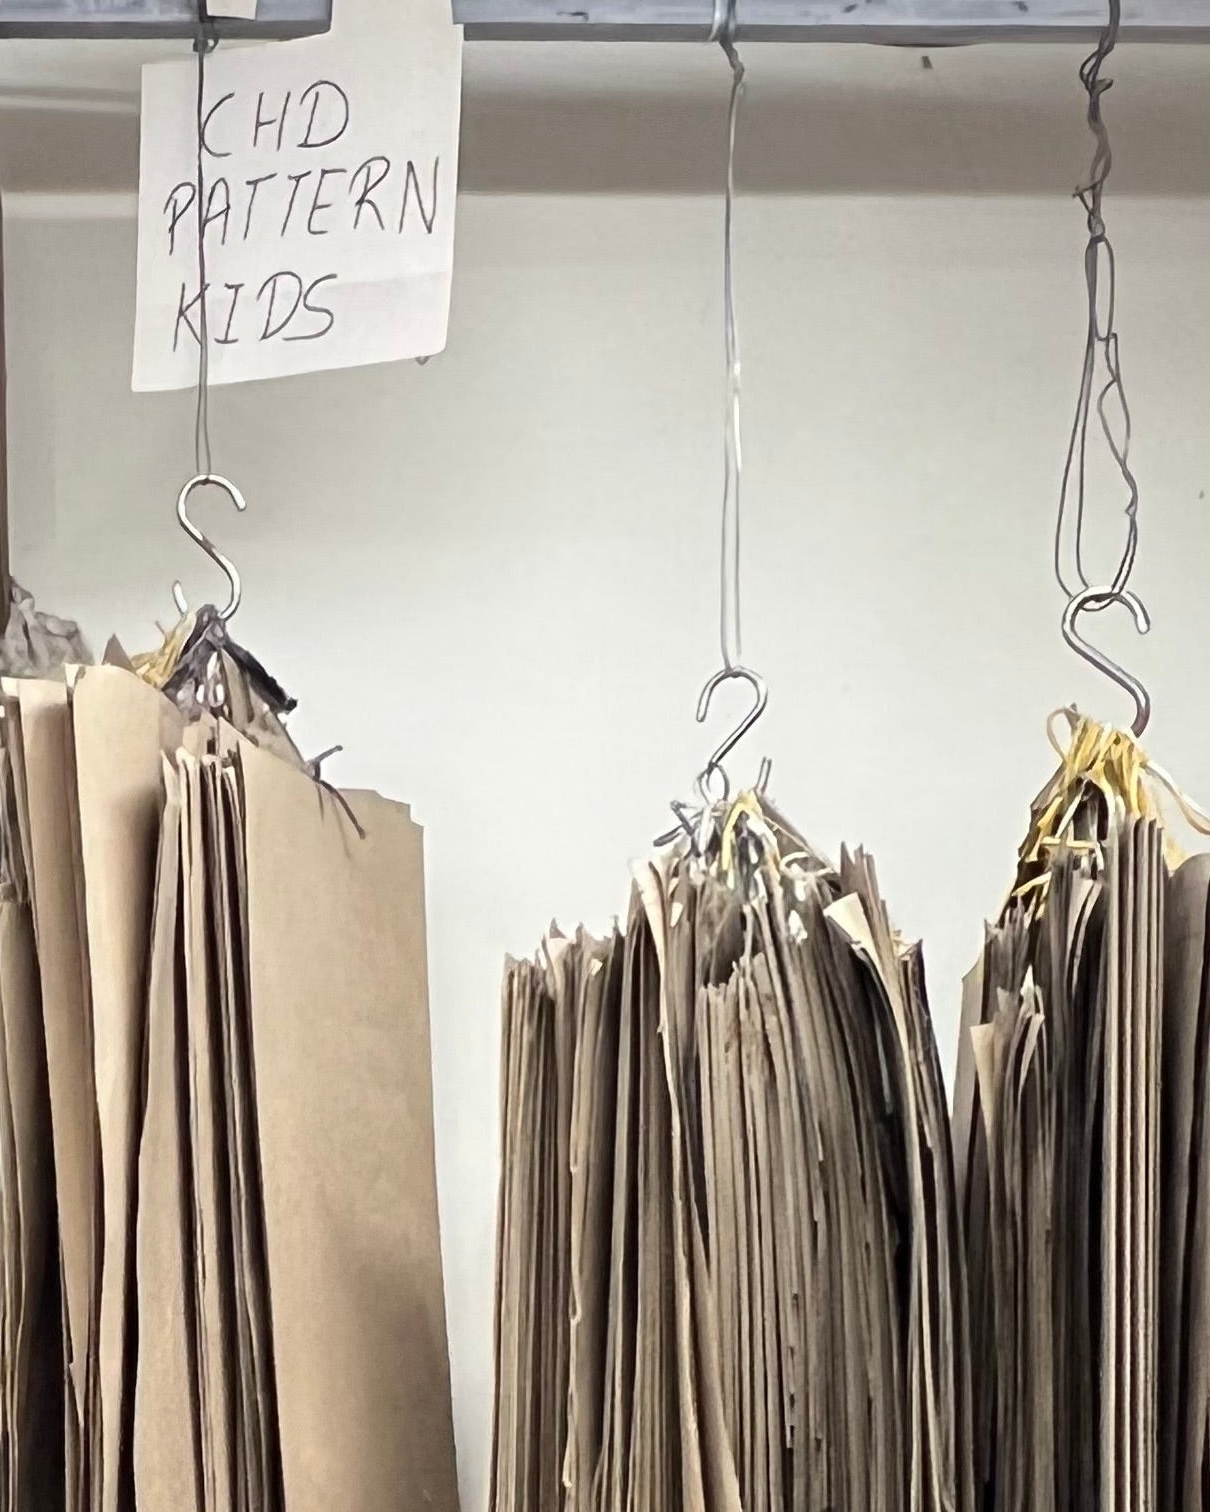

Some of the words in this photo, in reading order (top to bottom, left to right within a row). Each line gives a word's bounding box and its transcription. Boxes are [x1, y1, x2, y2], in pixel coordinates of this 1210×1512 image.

[201, 80, 349, 157] CHD
[163, 155, 439, 256] PATTERN
[173, 270, 338, 352] KIDS
